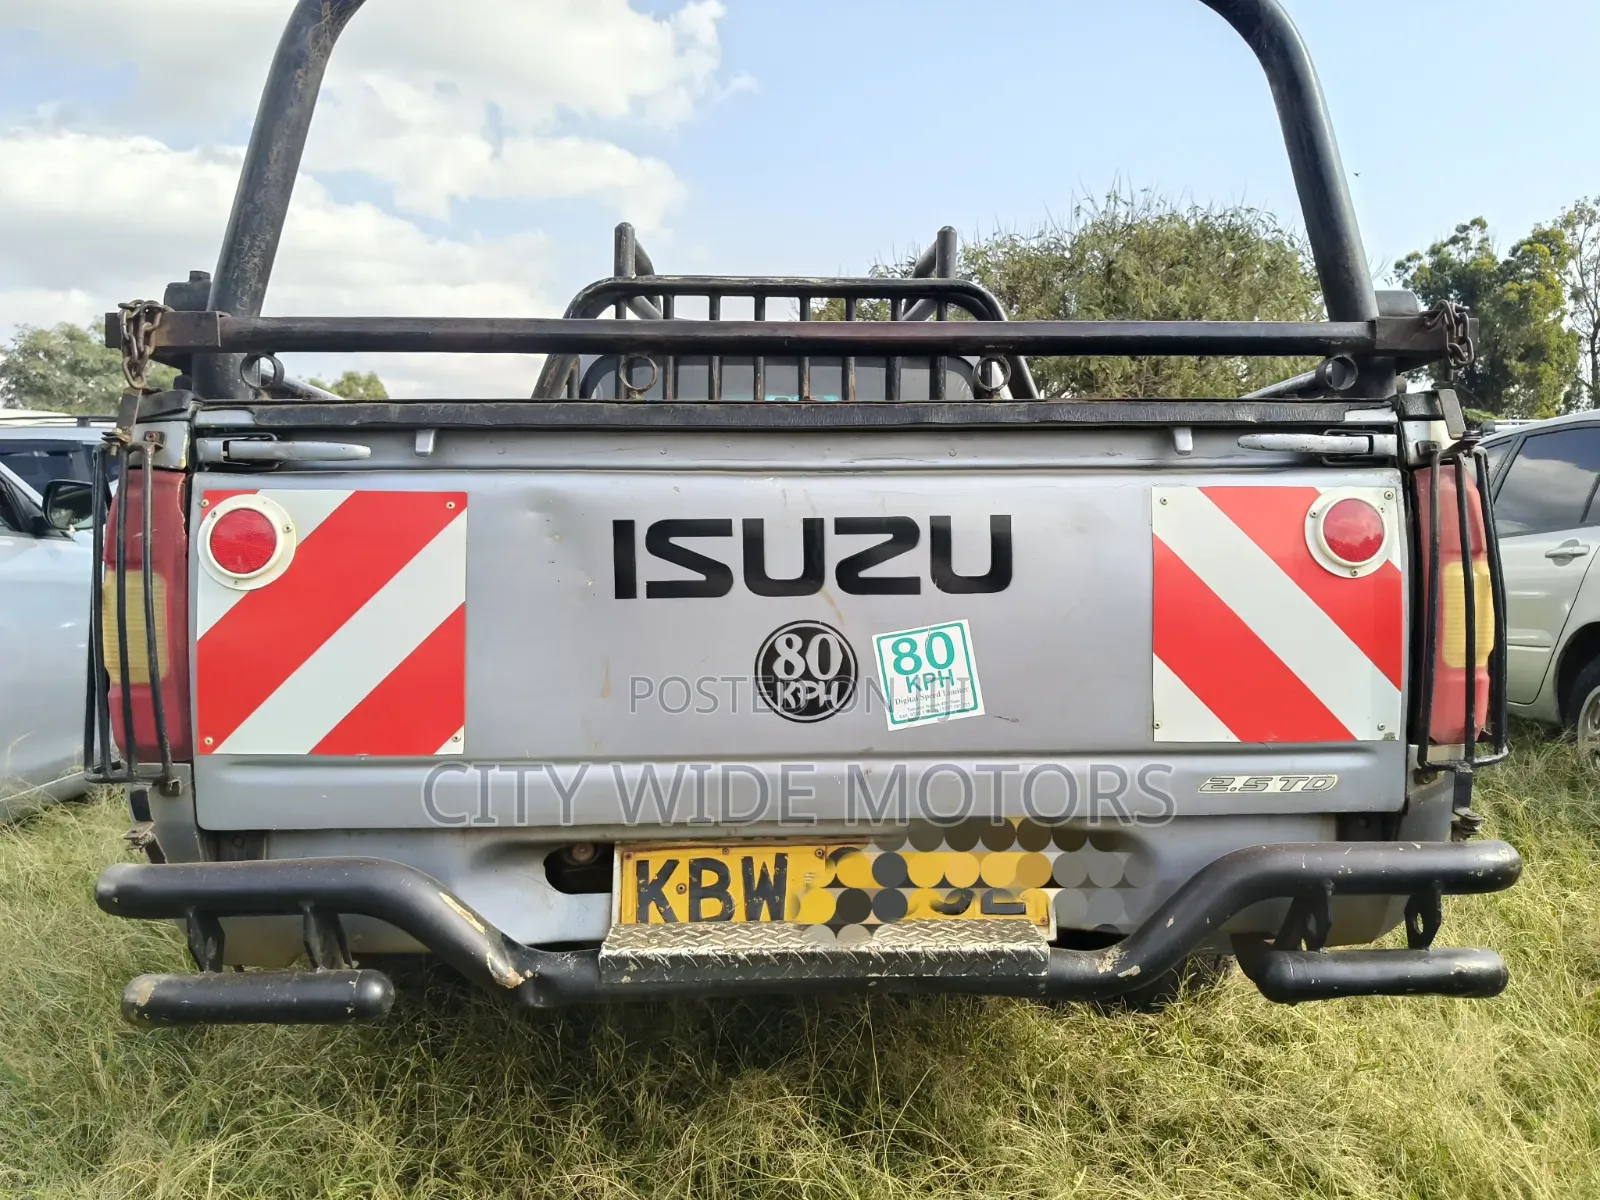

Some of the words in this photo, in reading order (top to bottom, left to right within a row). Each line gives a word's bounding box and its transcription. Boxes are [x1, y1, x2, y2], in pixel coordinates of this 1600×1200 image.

[613, 514, 1013, 599] ISUZU
[772, 633, 844, 681] 80
[891, 631, 955, 676] 80
[776, 680, 840, 712] KPH
[905, 669, 955, 693] KPH
[1199, 777, 1273, 792] 2.5
[636, 853, 788, 924] KBW
